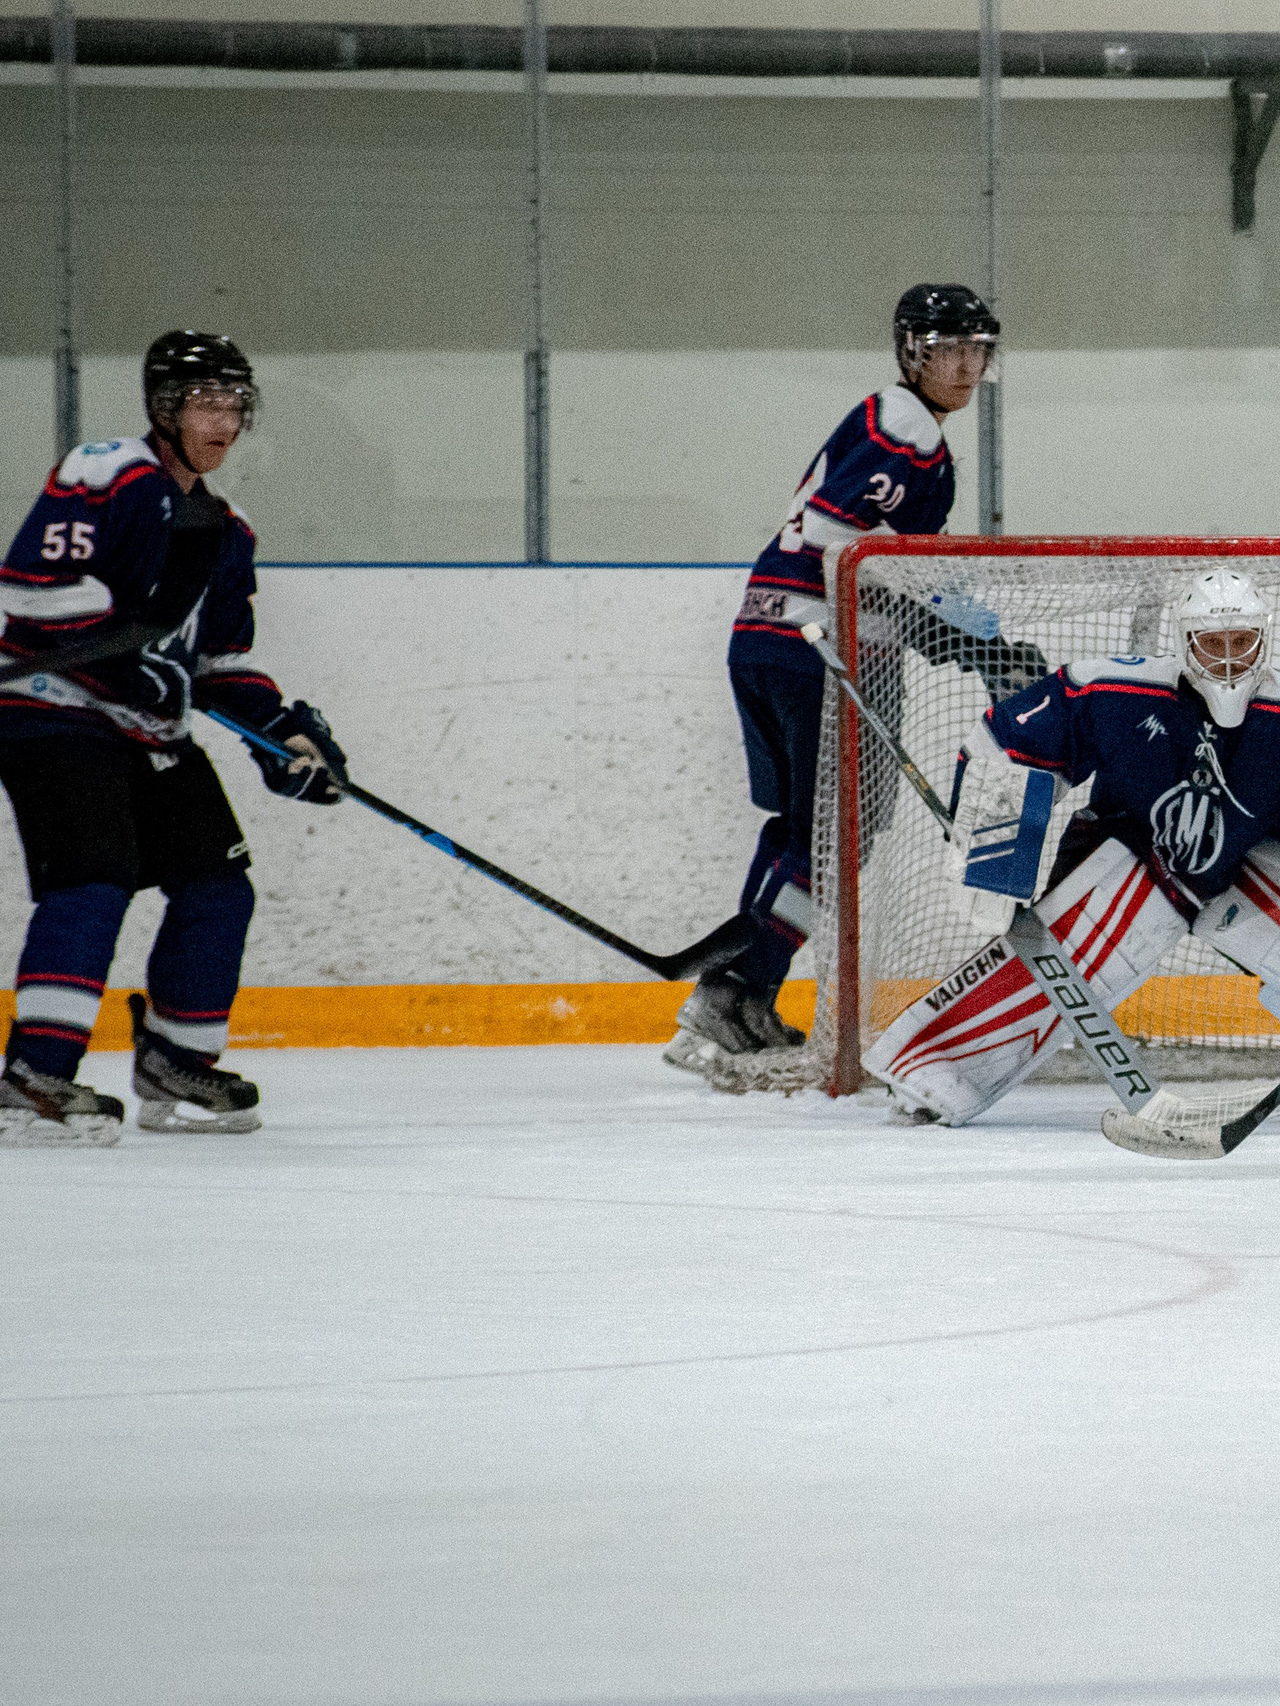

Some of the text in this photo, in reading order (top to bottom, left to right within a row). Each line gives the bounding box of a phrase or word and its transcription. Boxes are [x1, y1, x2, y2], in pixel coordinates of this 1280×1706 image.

[862, 472, 906, 513] 30
[40, 521, 96, 562] 55
[1015, 694, 1051, 725] 1
[924, 942, 1008, 1013] VAUGHN
[1032, 953, 1152, 1097] BAUER
